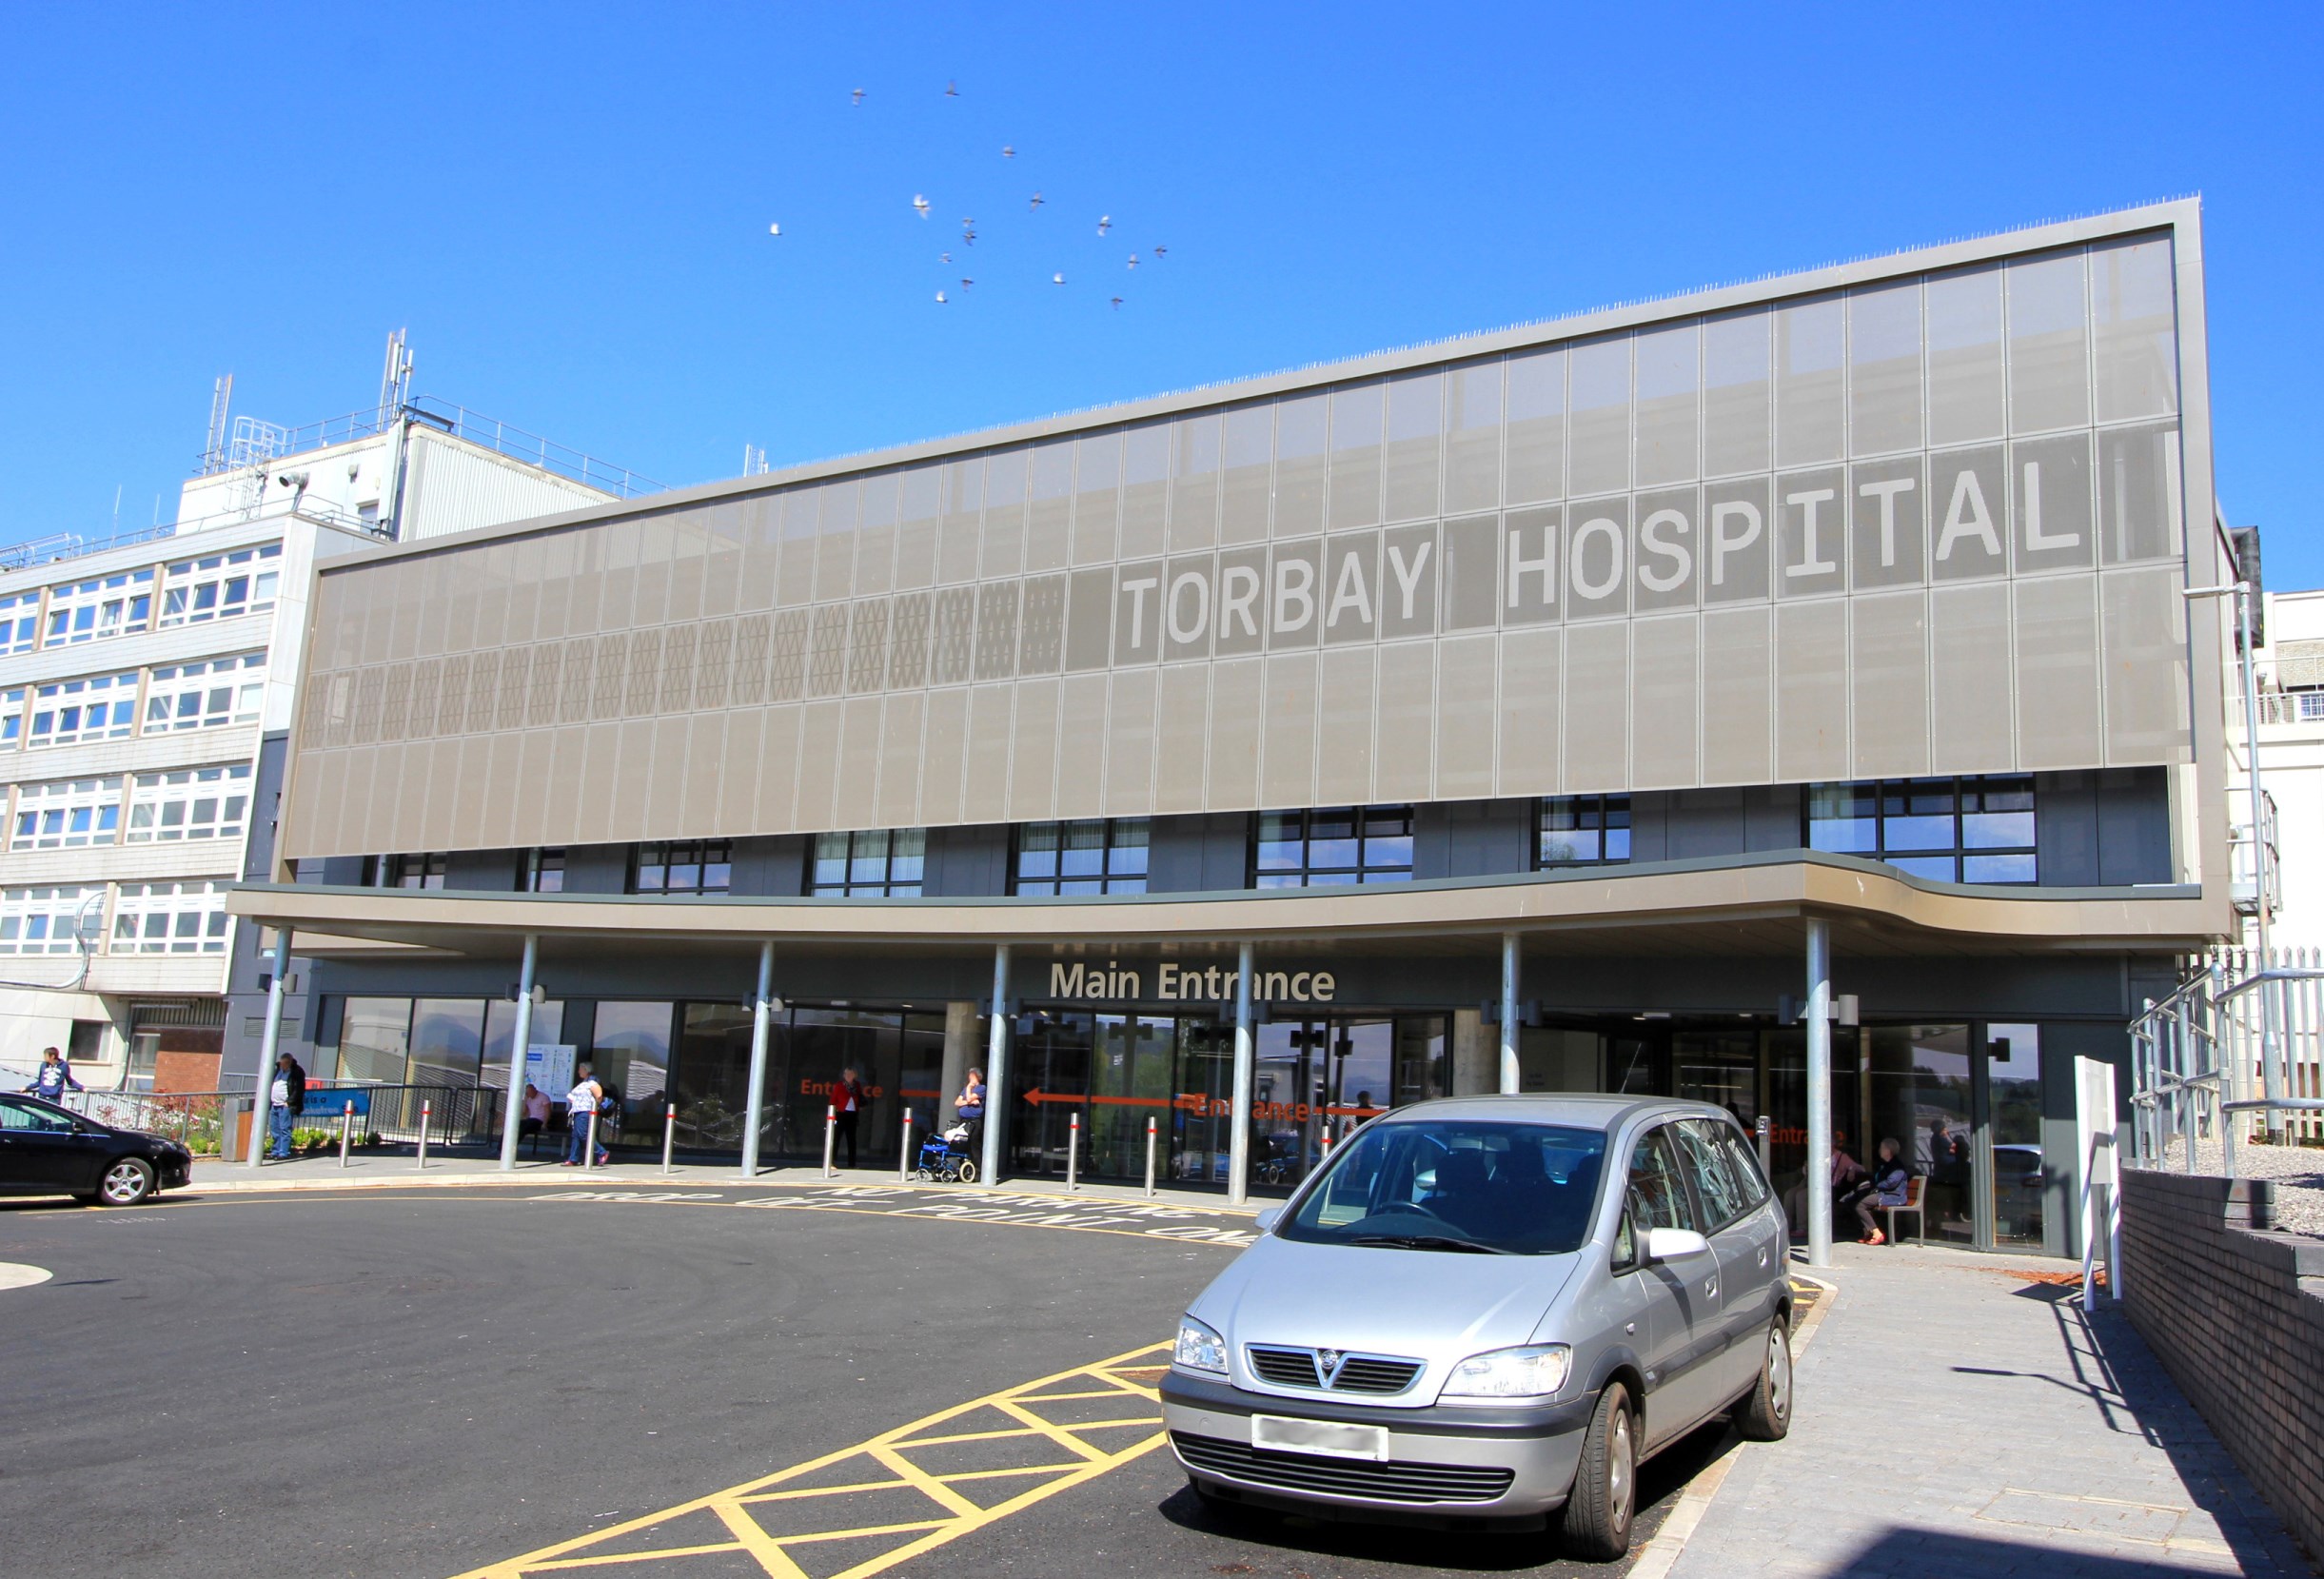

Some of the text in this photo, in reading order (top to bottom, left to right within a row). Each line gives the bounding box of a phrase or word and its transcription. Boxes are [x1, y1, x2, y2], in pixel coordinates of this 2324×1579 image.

[1121, 462, 2080, 649] TORBAY HOSPITAL
[1050, 960, 1140, 998] Main
[801, 1078, 883, 1097] Entce
[301, 1106, 339, 1115] okefree
[1193, 1094, 1310, 1122] Entance
[1771, 1124, 1845, 1146] Entre
[526, 1192, 723, 1202] DROP
[735, 1196, 896, 1208] OFF
[886, 1204, 1146, 1228] POINT
[807, 1187, 1222, 1218] NO PARKING
